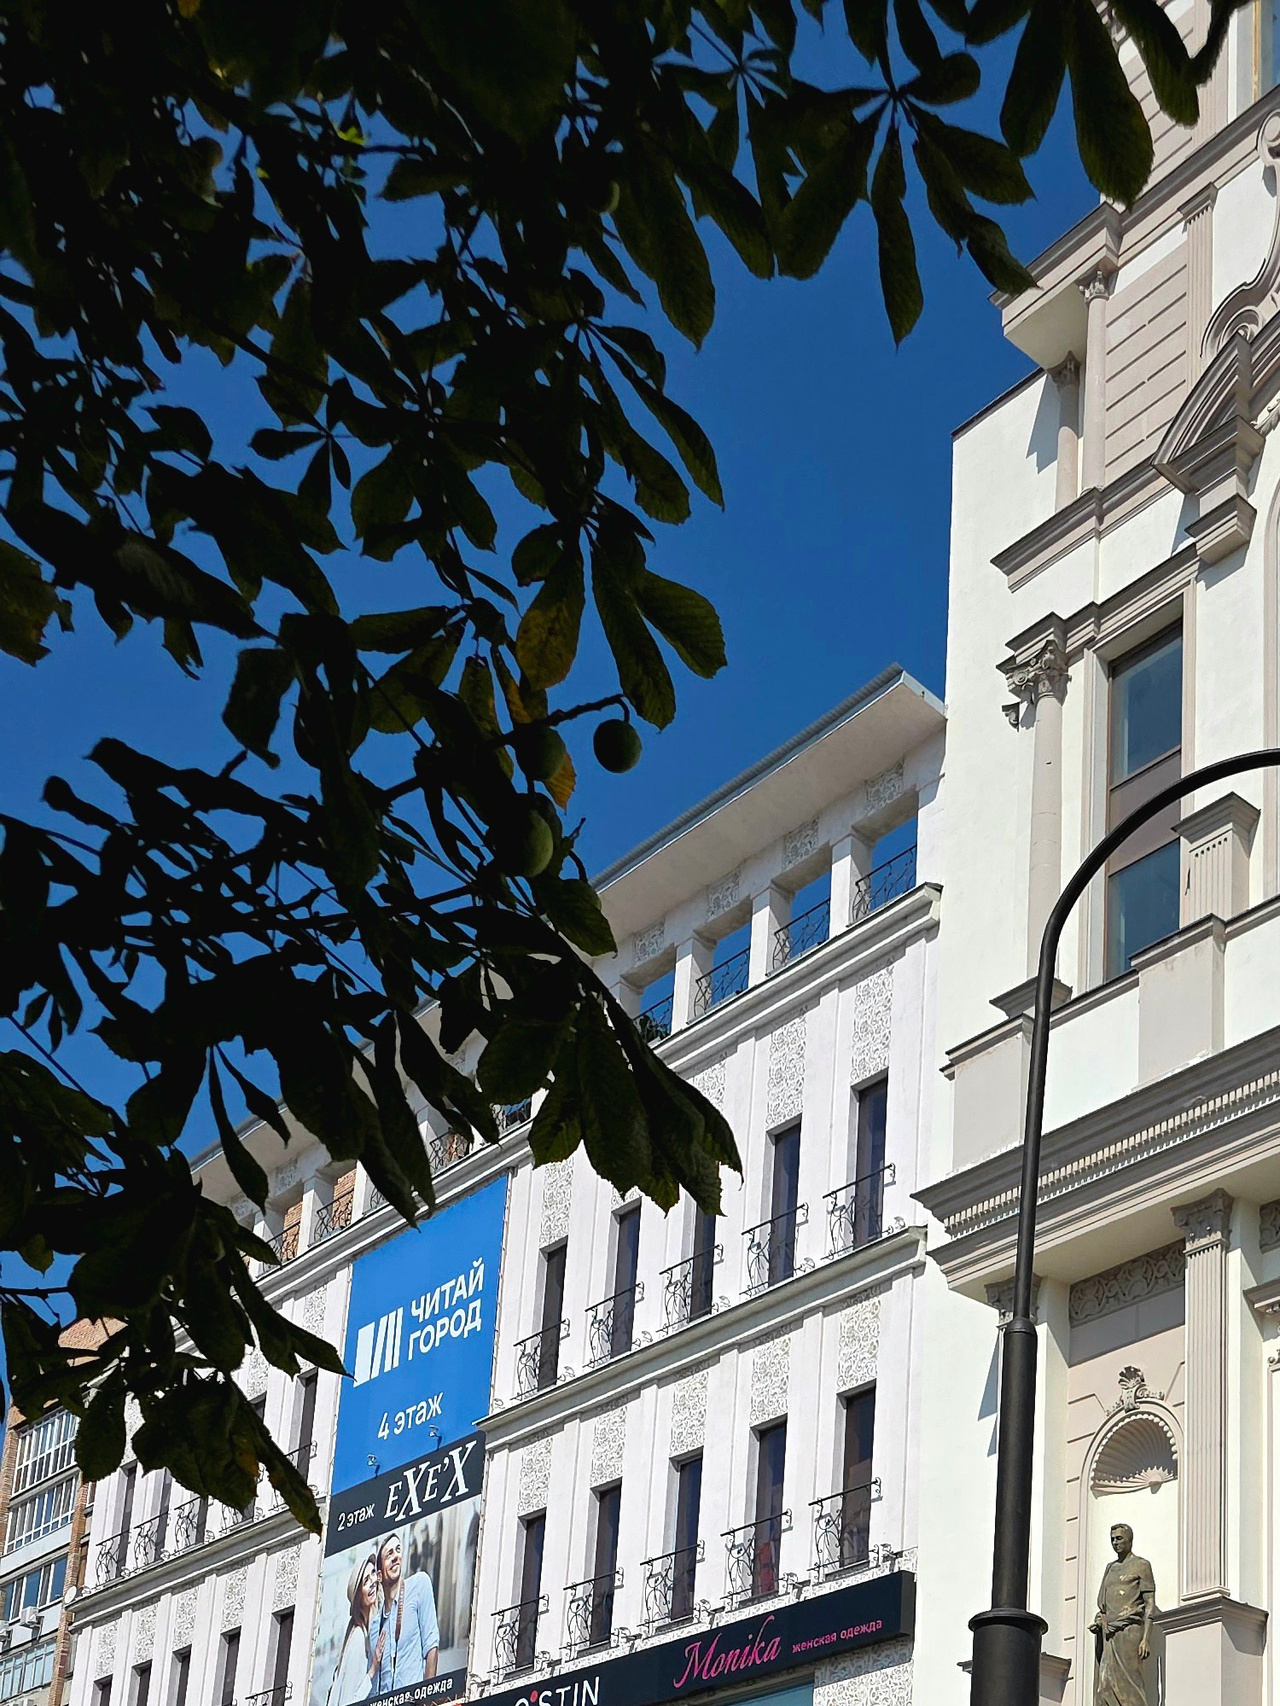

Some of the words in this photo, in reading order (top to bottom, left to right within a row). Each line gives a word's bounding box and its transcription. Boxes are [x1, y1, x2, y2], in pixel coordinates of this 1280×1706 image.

[410, 1257, 485, 1323] ЧИТАЙ
[408, 1299, 482, 1361] ГОРОД
[377, 1412, 390, 1440] 4
[394, 1392, 444, 1435] этаж
[337, 1512, 346, 1531] 2
[346, 1503, 376, 1528] этаж
[672, 1615, 783, 1689] Monika
[792, 1632, 837, 1654] женская
[840, 1620, 883, 1639] одежда
[414, 1677, 453, 1700] одежда
